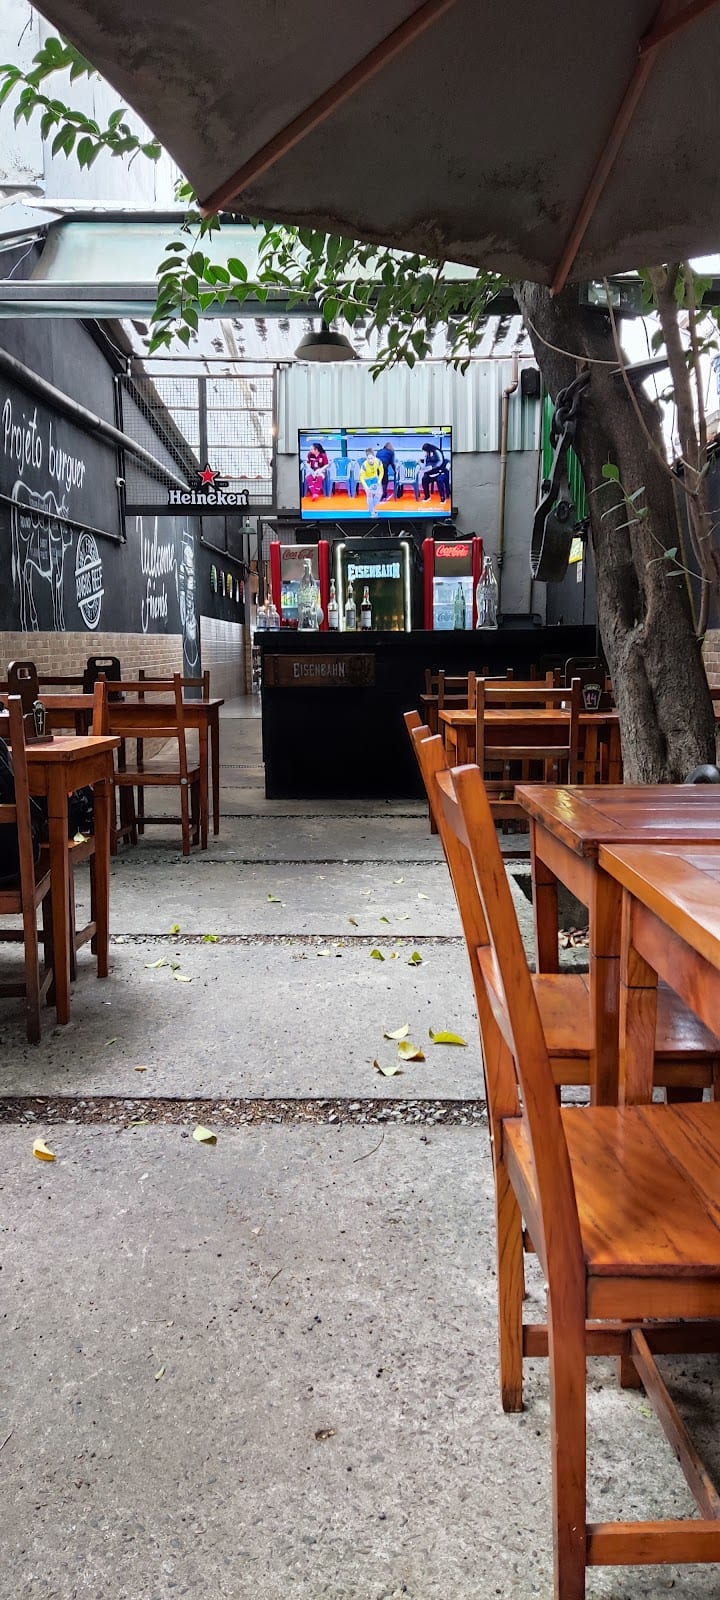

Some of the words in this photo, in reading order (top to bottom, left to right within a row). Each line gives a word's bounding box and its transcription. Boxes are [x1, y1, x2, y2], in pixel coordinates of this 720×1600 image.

[2, 398, 42, 476] Projeto
[49, 421, 85, 492] burguer
[169, 490, 247, 505] Heineken
[348, 563, 400, 581] EISENBAHN
[294, 662, 345, 677] EISENBAHN
